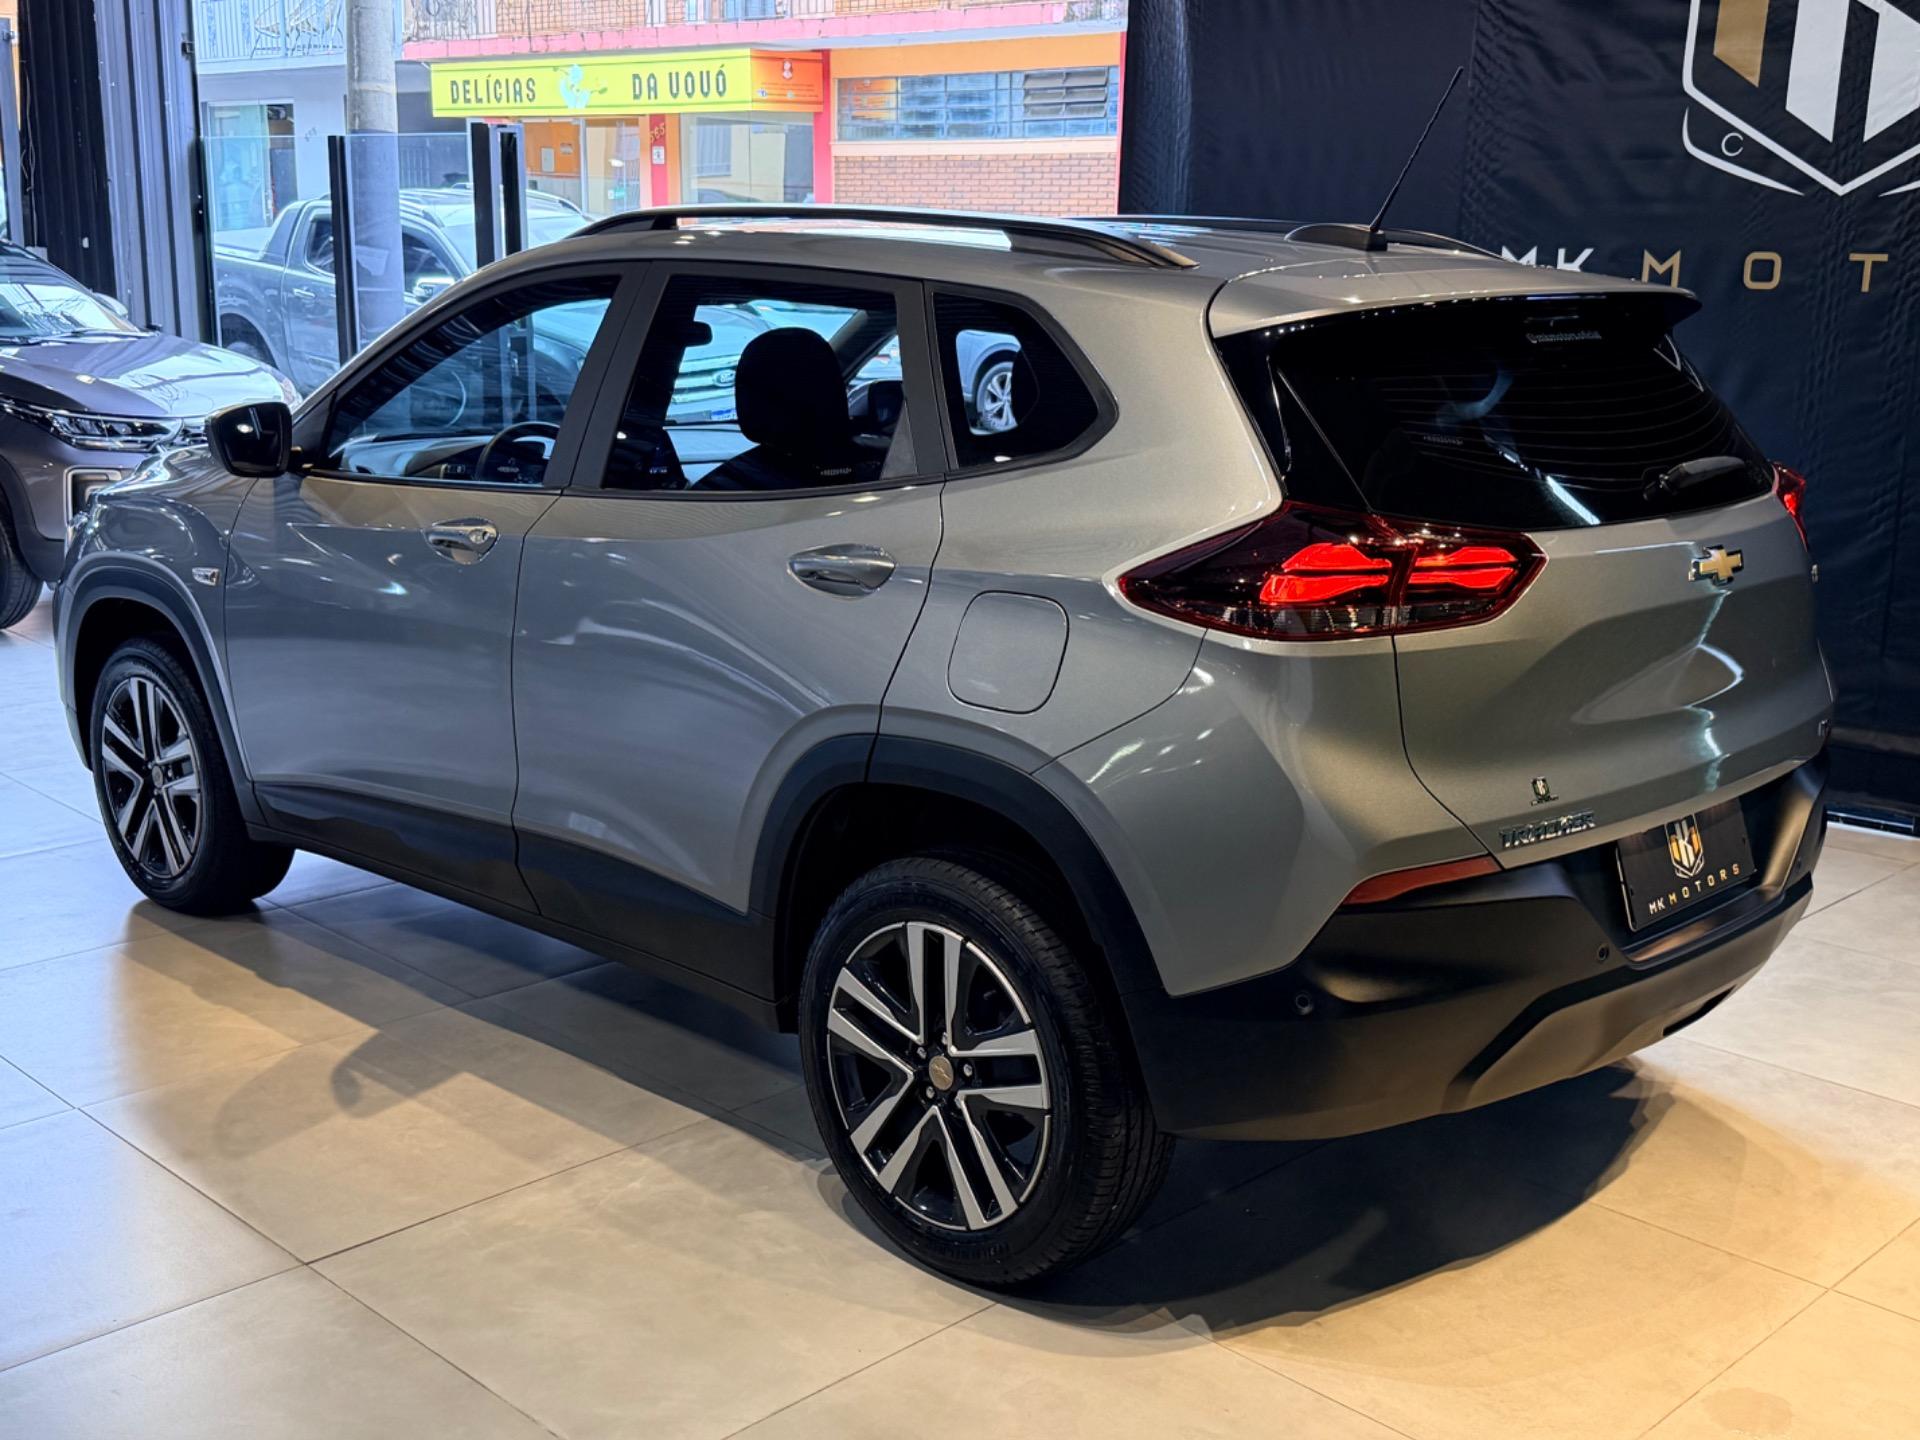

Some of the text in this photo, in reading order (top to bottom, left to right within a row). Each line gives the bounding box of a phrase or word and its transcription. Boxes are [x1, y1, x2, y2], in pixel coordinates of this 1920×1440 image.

[450, 74, 536, 104] DELÍCIAS
[632, 73, 658, 100] DA
[1499, 808, 1596, 850] TRACKER
[1648, 863, 1741, 915] MK MOTORS
